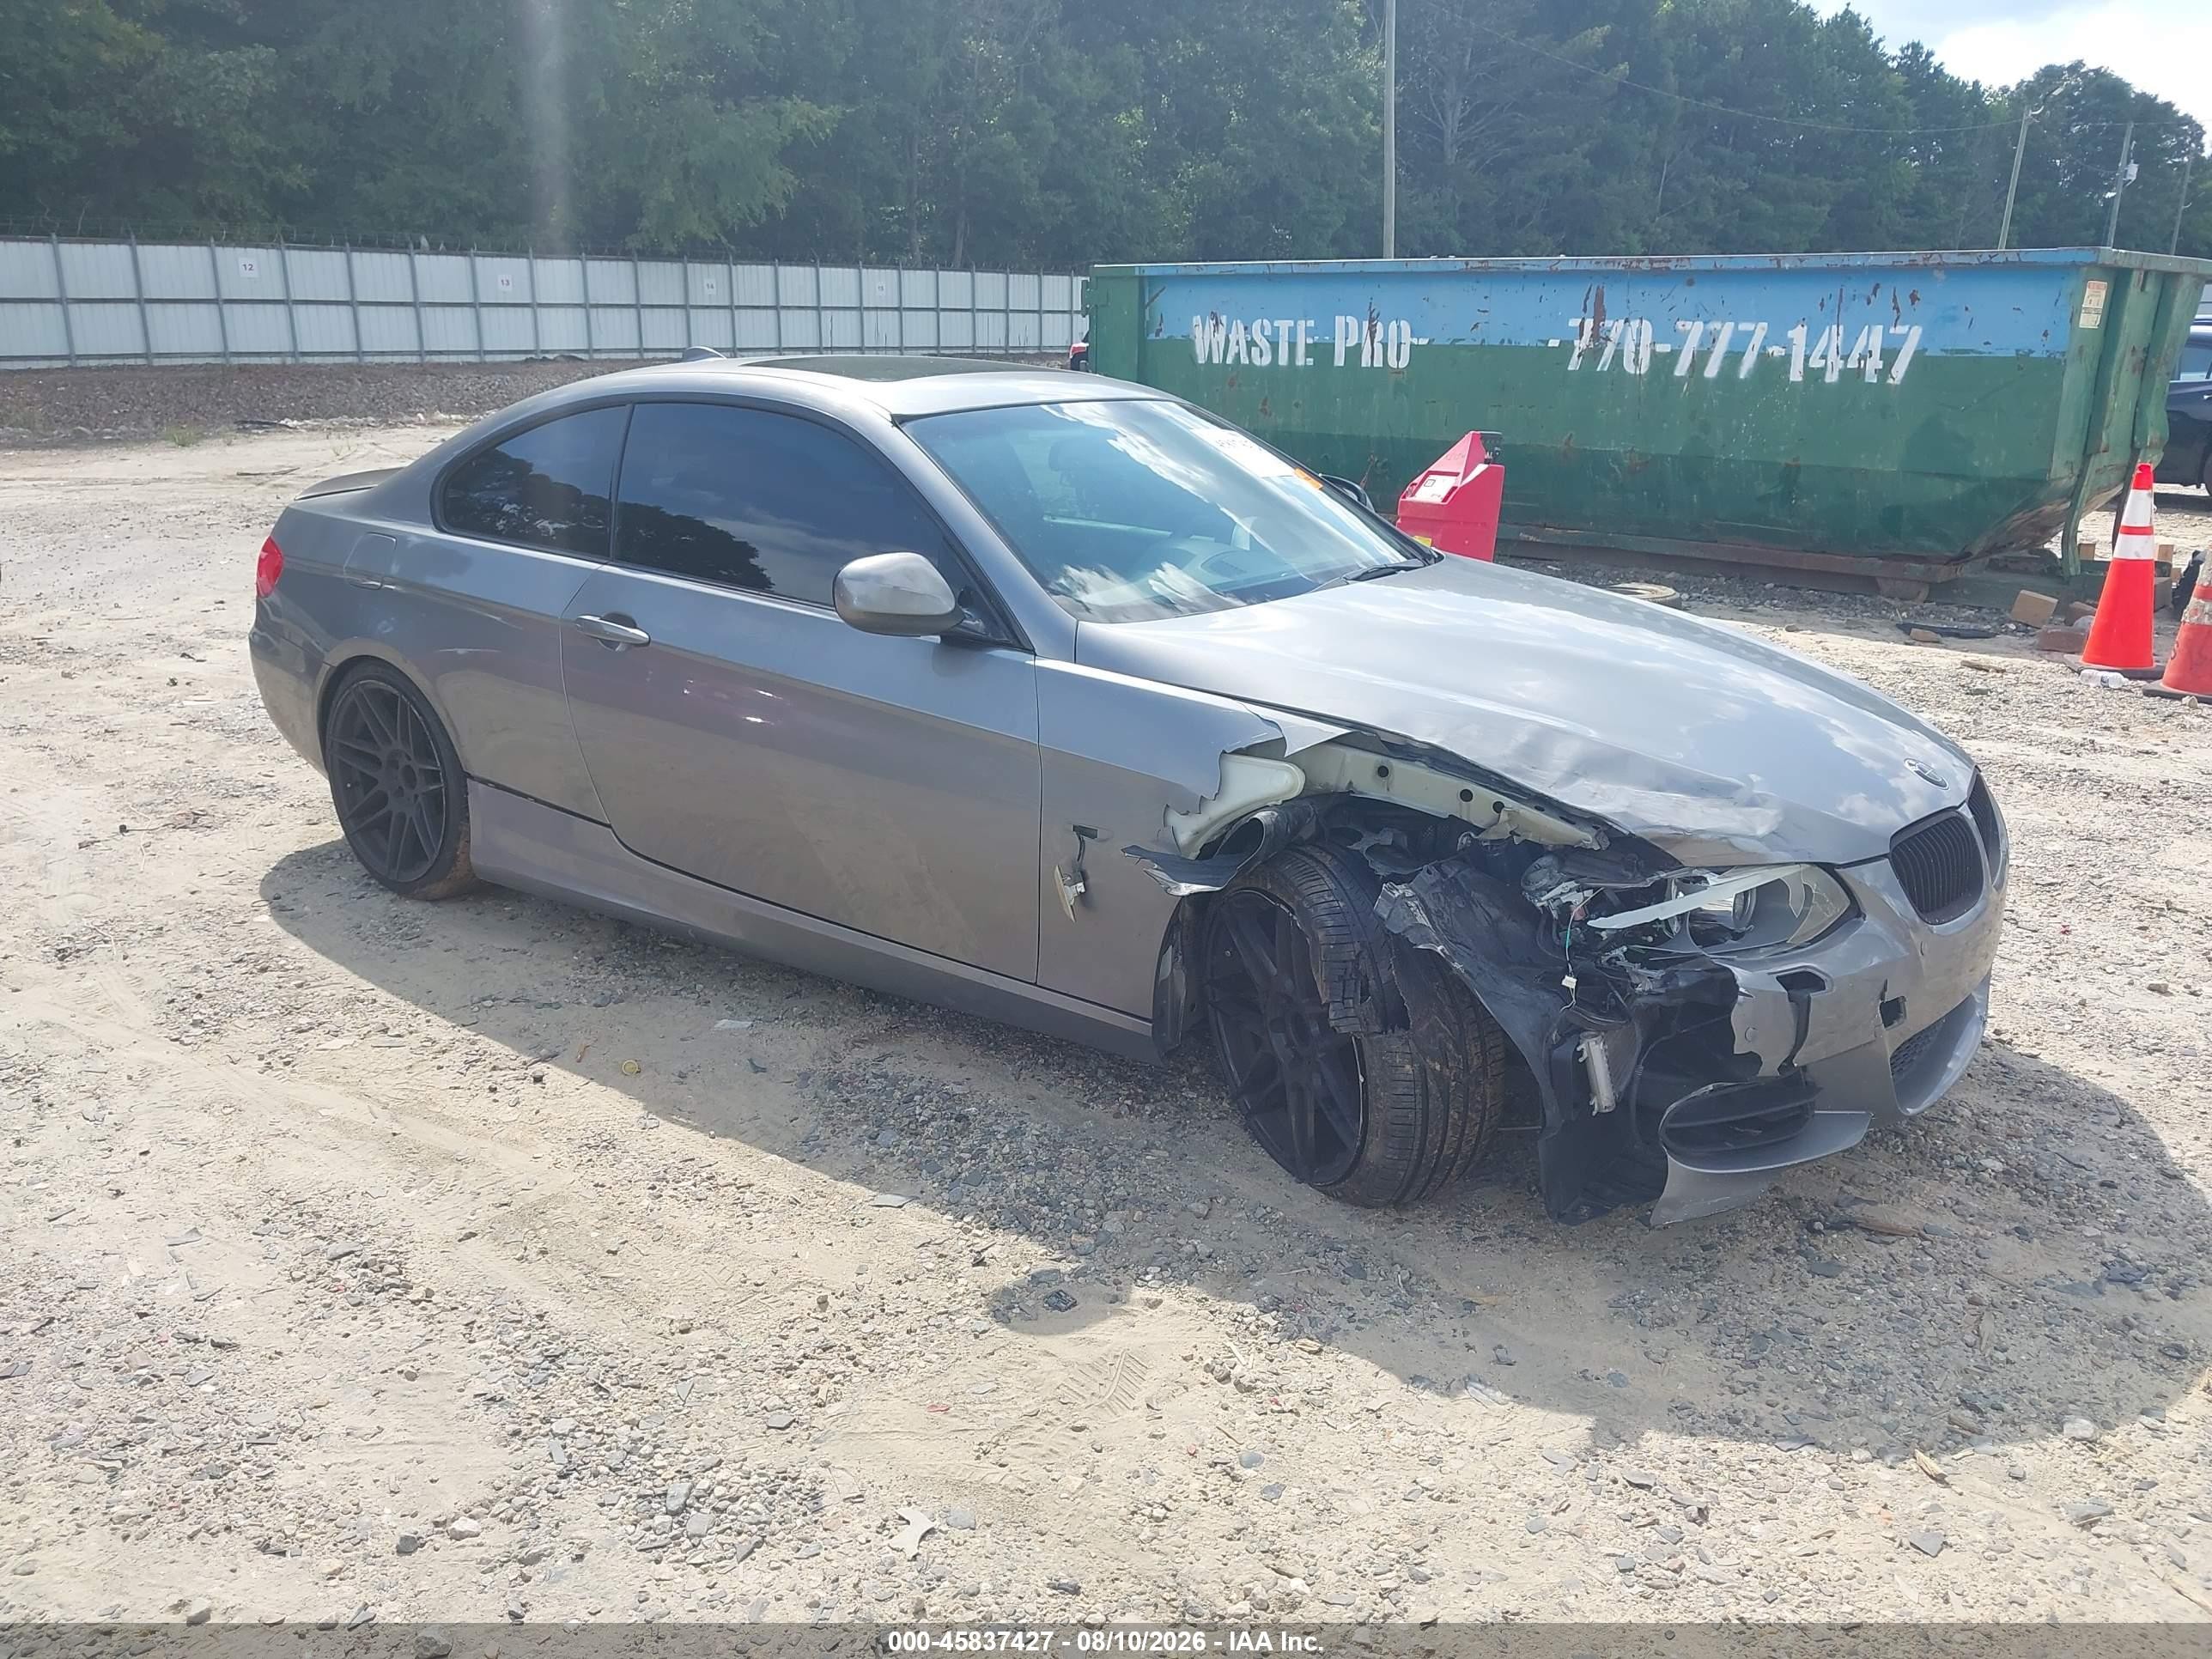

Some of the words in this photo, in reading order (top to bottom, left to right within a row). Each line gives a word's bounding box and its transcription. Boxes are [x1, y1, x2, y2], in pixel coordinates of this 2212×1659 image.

[241, 263, 254, 271] 12
[1192, 314, 1315, 366] WASTE
[1334, 315, 1412, 369] PRO
